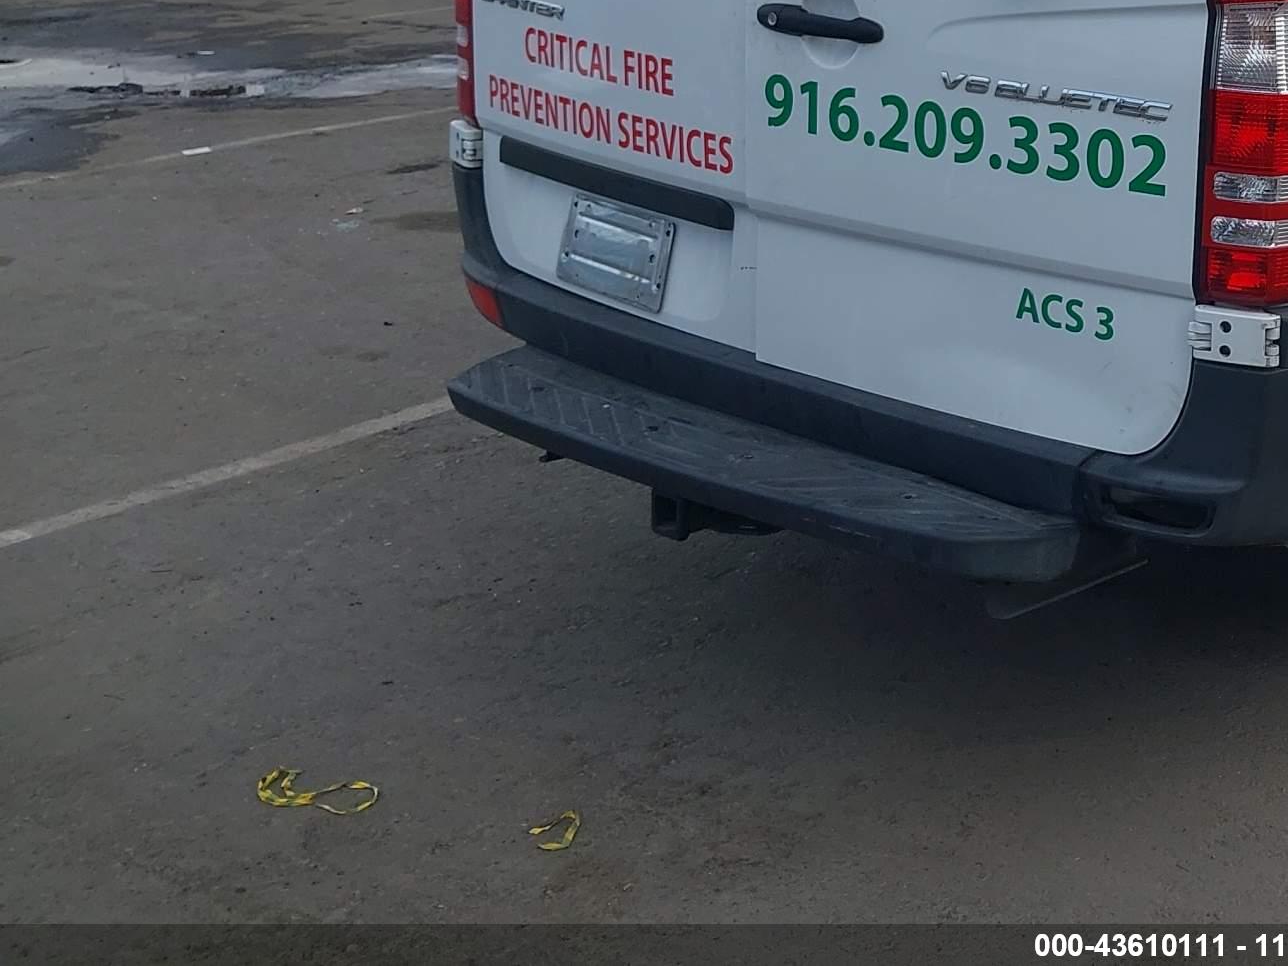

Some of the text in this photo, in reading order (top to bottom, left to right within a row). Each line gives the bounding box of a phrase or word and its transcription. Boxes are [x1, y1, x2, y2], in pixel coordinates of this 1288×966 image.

[525, 27, 674, 97] CRITICAL FIRE
[939, 70, 1174, 122] V6 BLUETEC
[489, 74, 734, 175] PREVENTION SERVICES
[764, 73, 1167, 198] 916.209.3302
[1015, 287, 1115, 342] ACS 3
